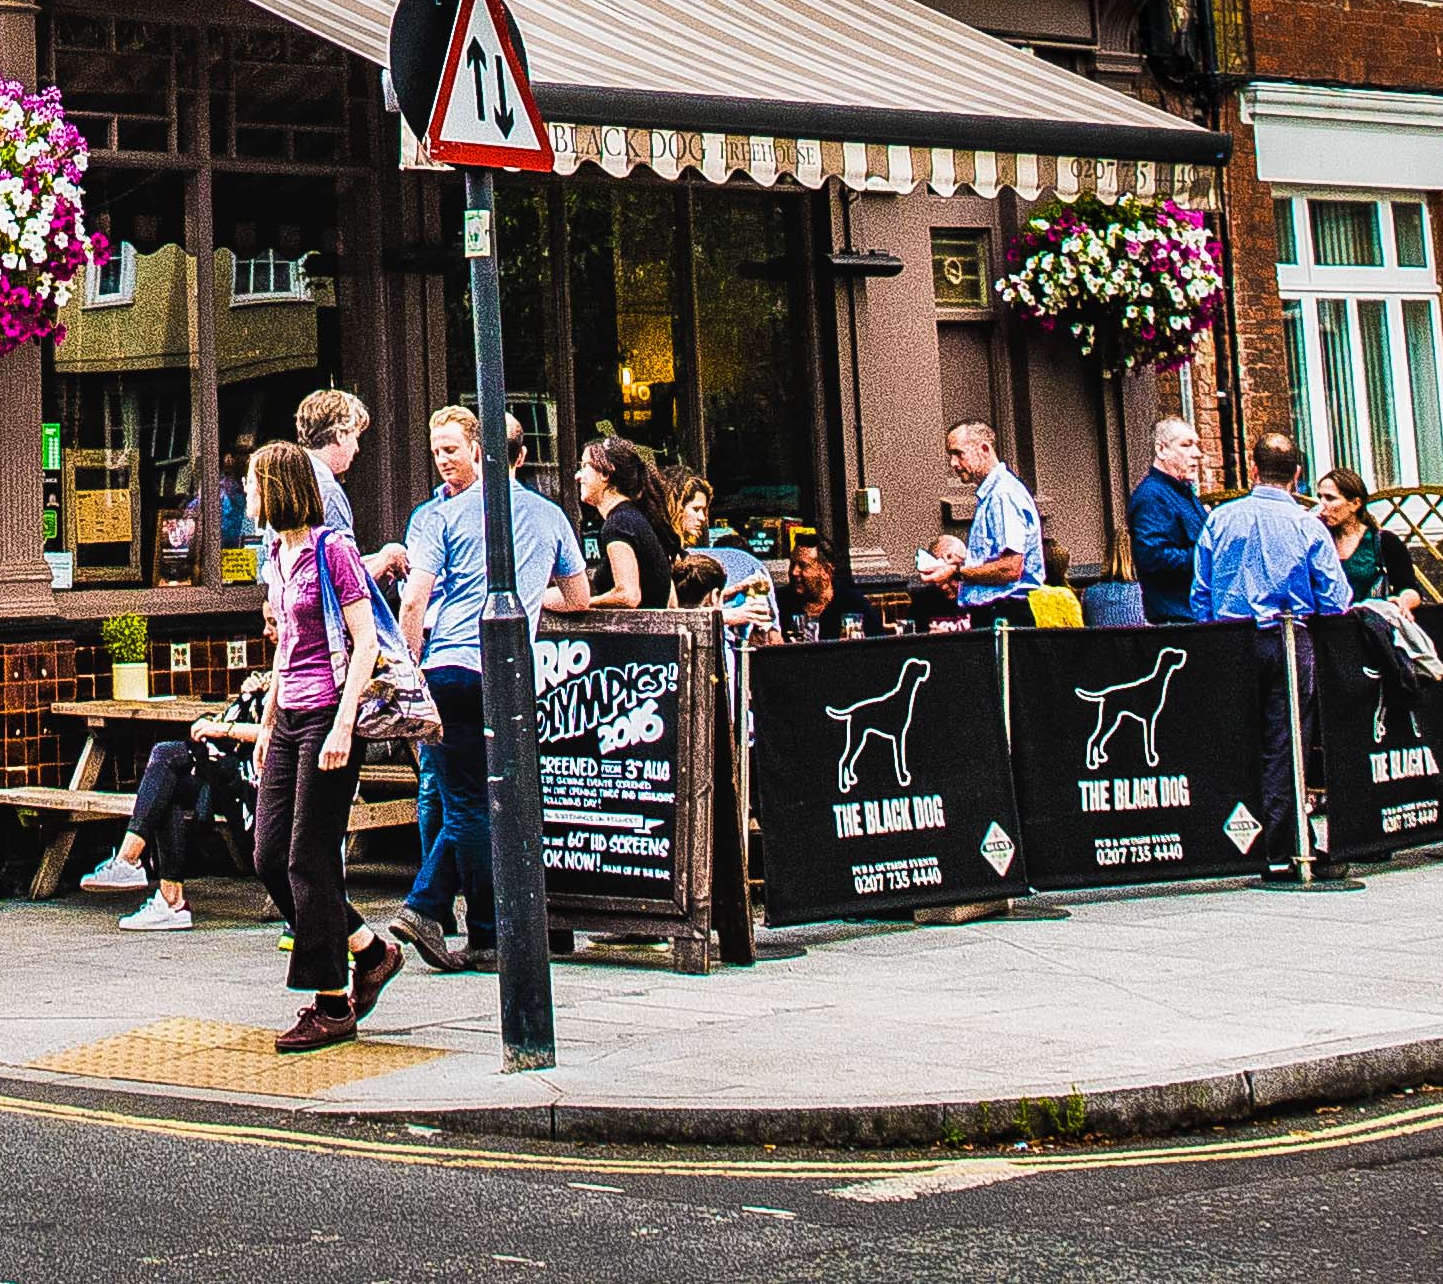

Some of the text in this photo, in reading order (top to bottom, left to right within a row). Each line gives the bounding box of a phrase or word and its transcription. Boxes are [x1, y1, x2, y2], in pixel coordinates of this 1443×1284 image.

[554, 124, 640, 159] BLACK
[650, 129, 708, 162] DOG
[533, 640, 591, 696] RIO
[598, 698, 664, 754] 2016
[540, 756, 598, 777] CREENED
[643, 760, 671, 781] AUG
[1369, 753, 1390, 783] THE
[1389, 748, 1424, 780] BLACK
[1078, 774, 1191, 812] THE BLACK DOG
[832, 794, 946, 839] THE BLACK DOG
[542, 849, 563, 869] OK
[564, 850, 601, 872] NOW!
[590, 833, 608, 851] HD
[608, 834, 670, 858] SCREENS
[1096, 842, 1184, 866] 0207 735 4440
[854, 866, 942, 894] 0207 735 4440
